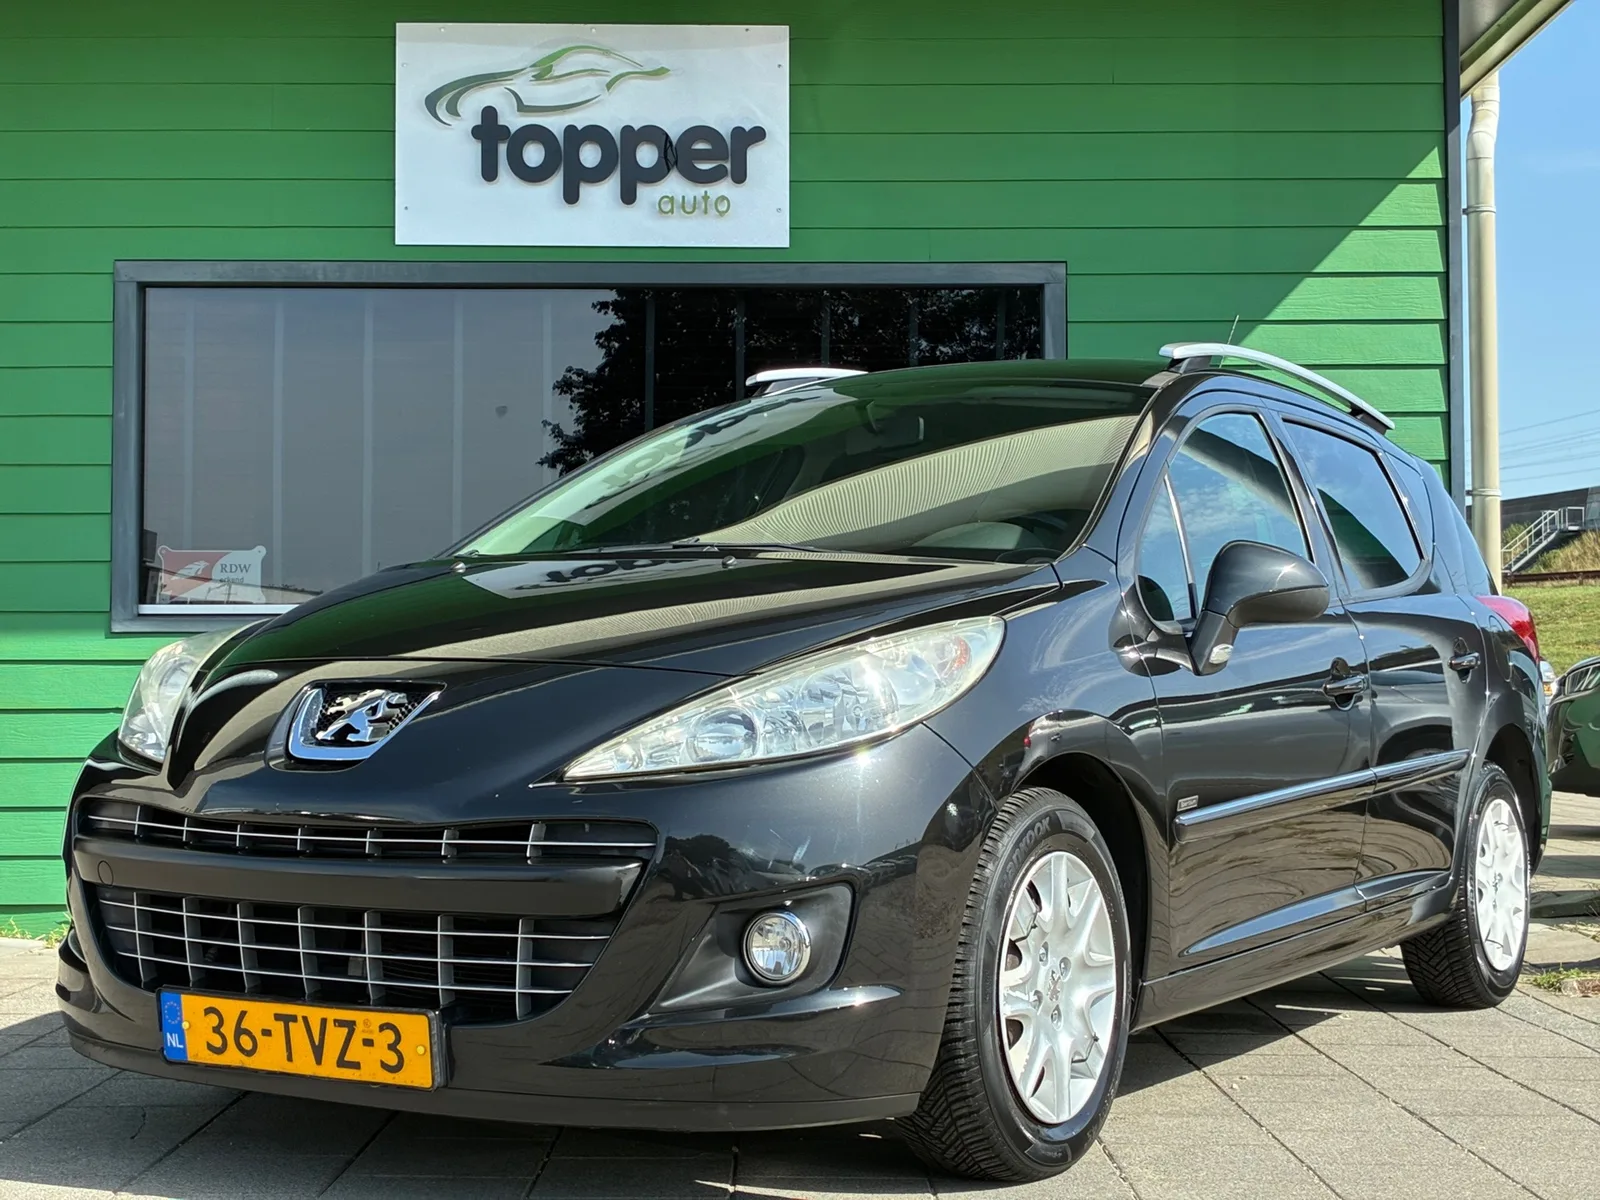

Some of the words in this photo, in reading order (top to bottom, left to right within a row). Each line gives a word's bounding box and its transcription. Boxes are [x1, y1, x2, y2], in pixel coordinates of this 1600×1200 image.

[471, 105, 766, 205] topper
[658, 191, 730, 216] auto
[220, 563, 251, 573] RDW
[167, 1033, 183, 1048] NL
[203, 1006, 405, 1073] 36-TVZ-3
